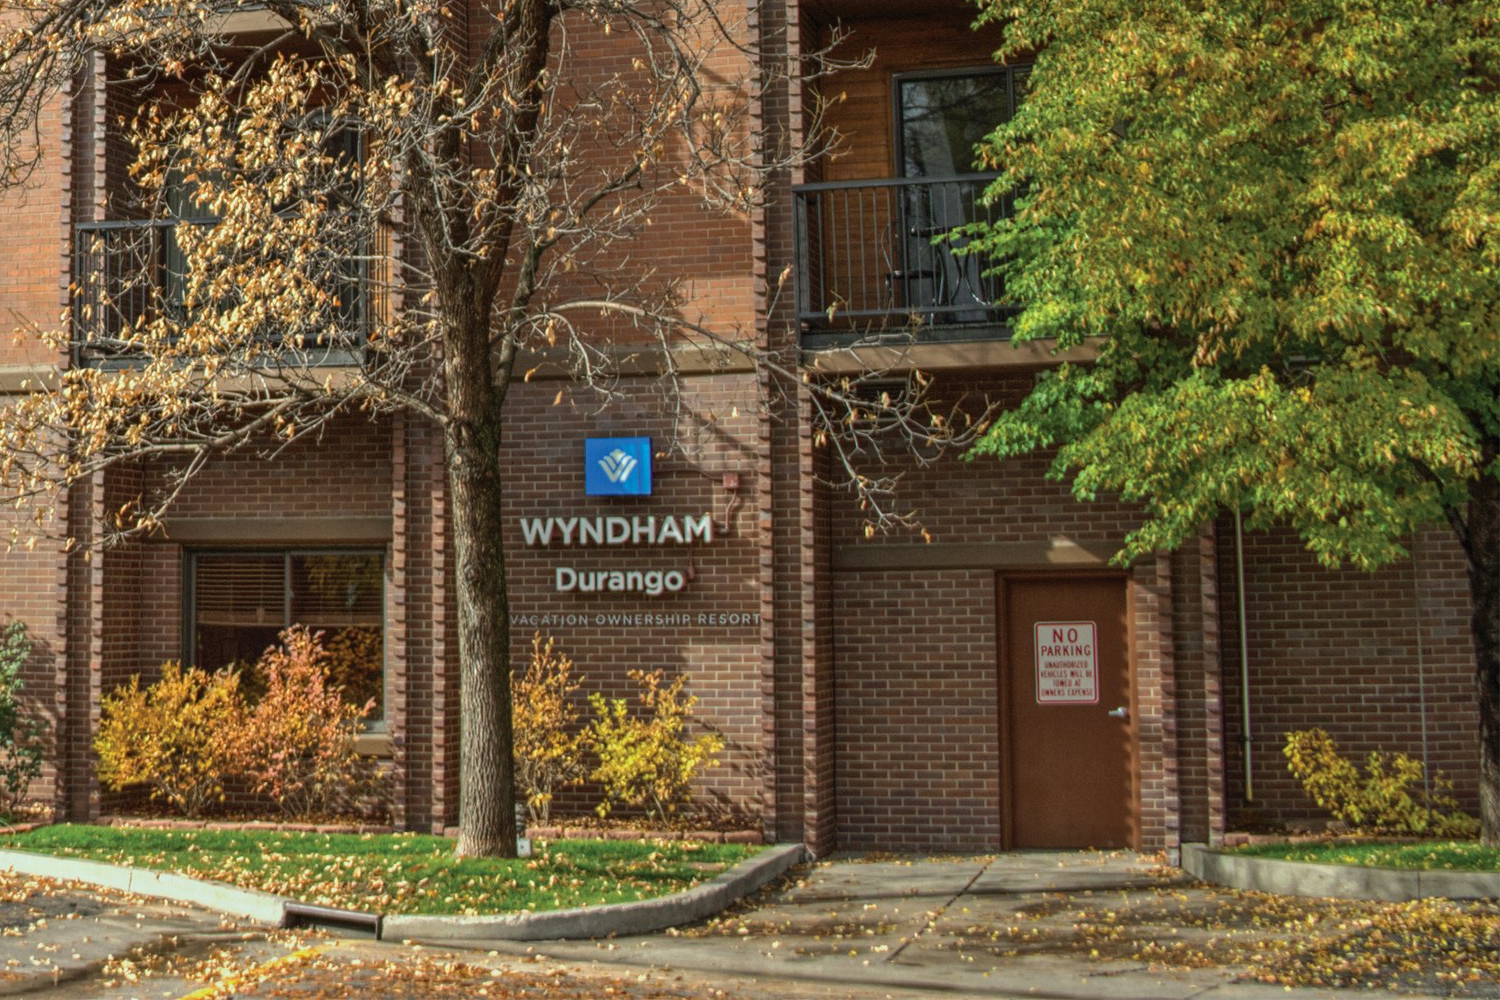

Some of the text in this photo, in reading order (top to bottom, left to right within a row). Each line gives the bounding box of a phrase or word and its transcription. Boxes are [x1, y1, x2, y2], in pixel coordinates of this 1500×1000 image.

[520, 514, 713, 545] WYNDHAM
[556, 567, 684, 596] Durango
[510, 613, 760, 626] VACATION OWNERSHIP RESORT
[1052, 628, 1078, 643] NO
[1041, 645, 1091, 657] PARKING
[1044, 661, 1088, 669] UNAUTHORIZED
